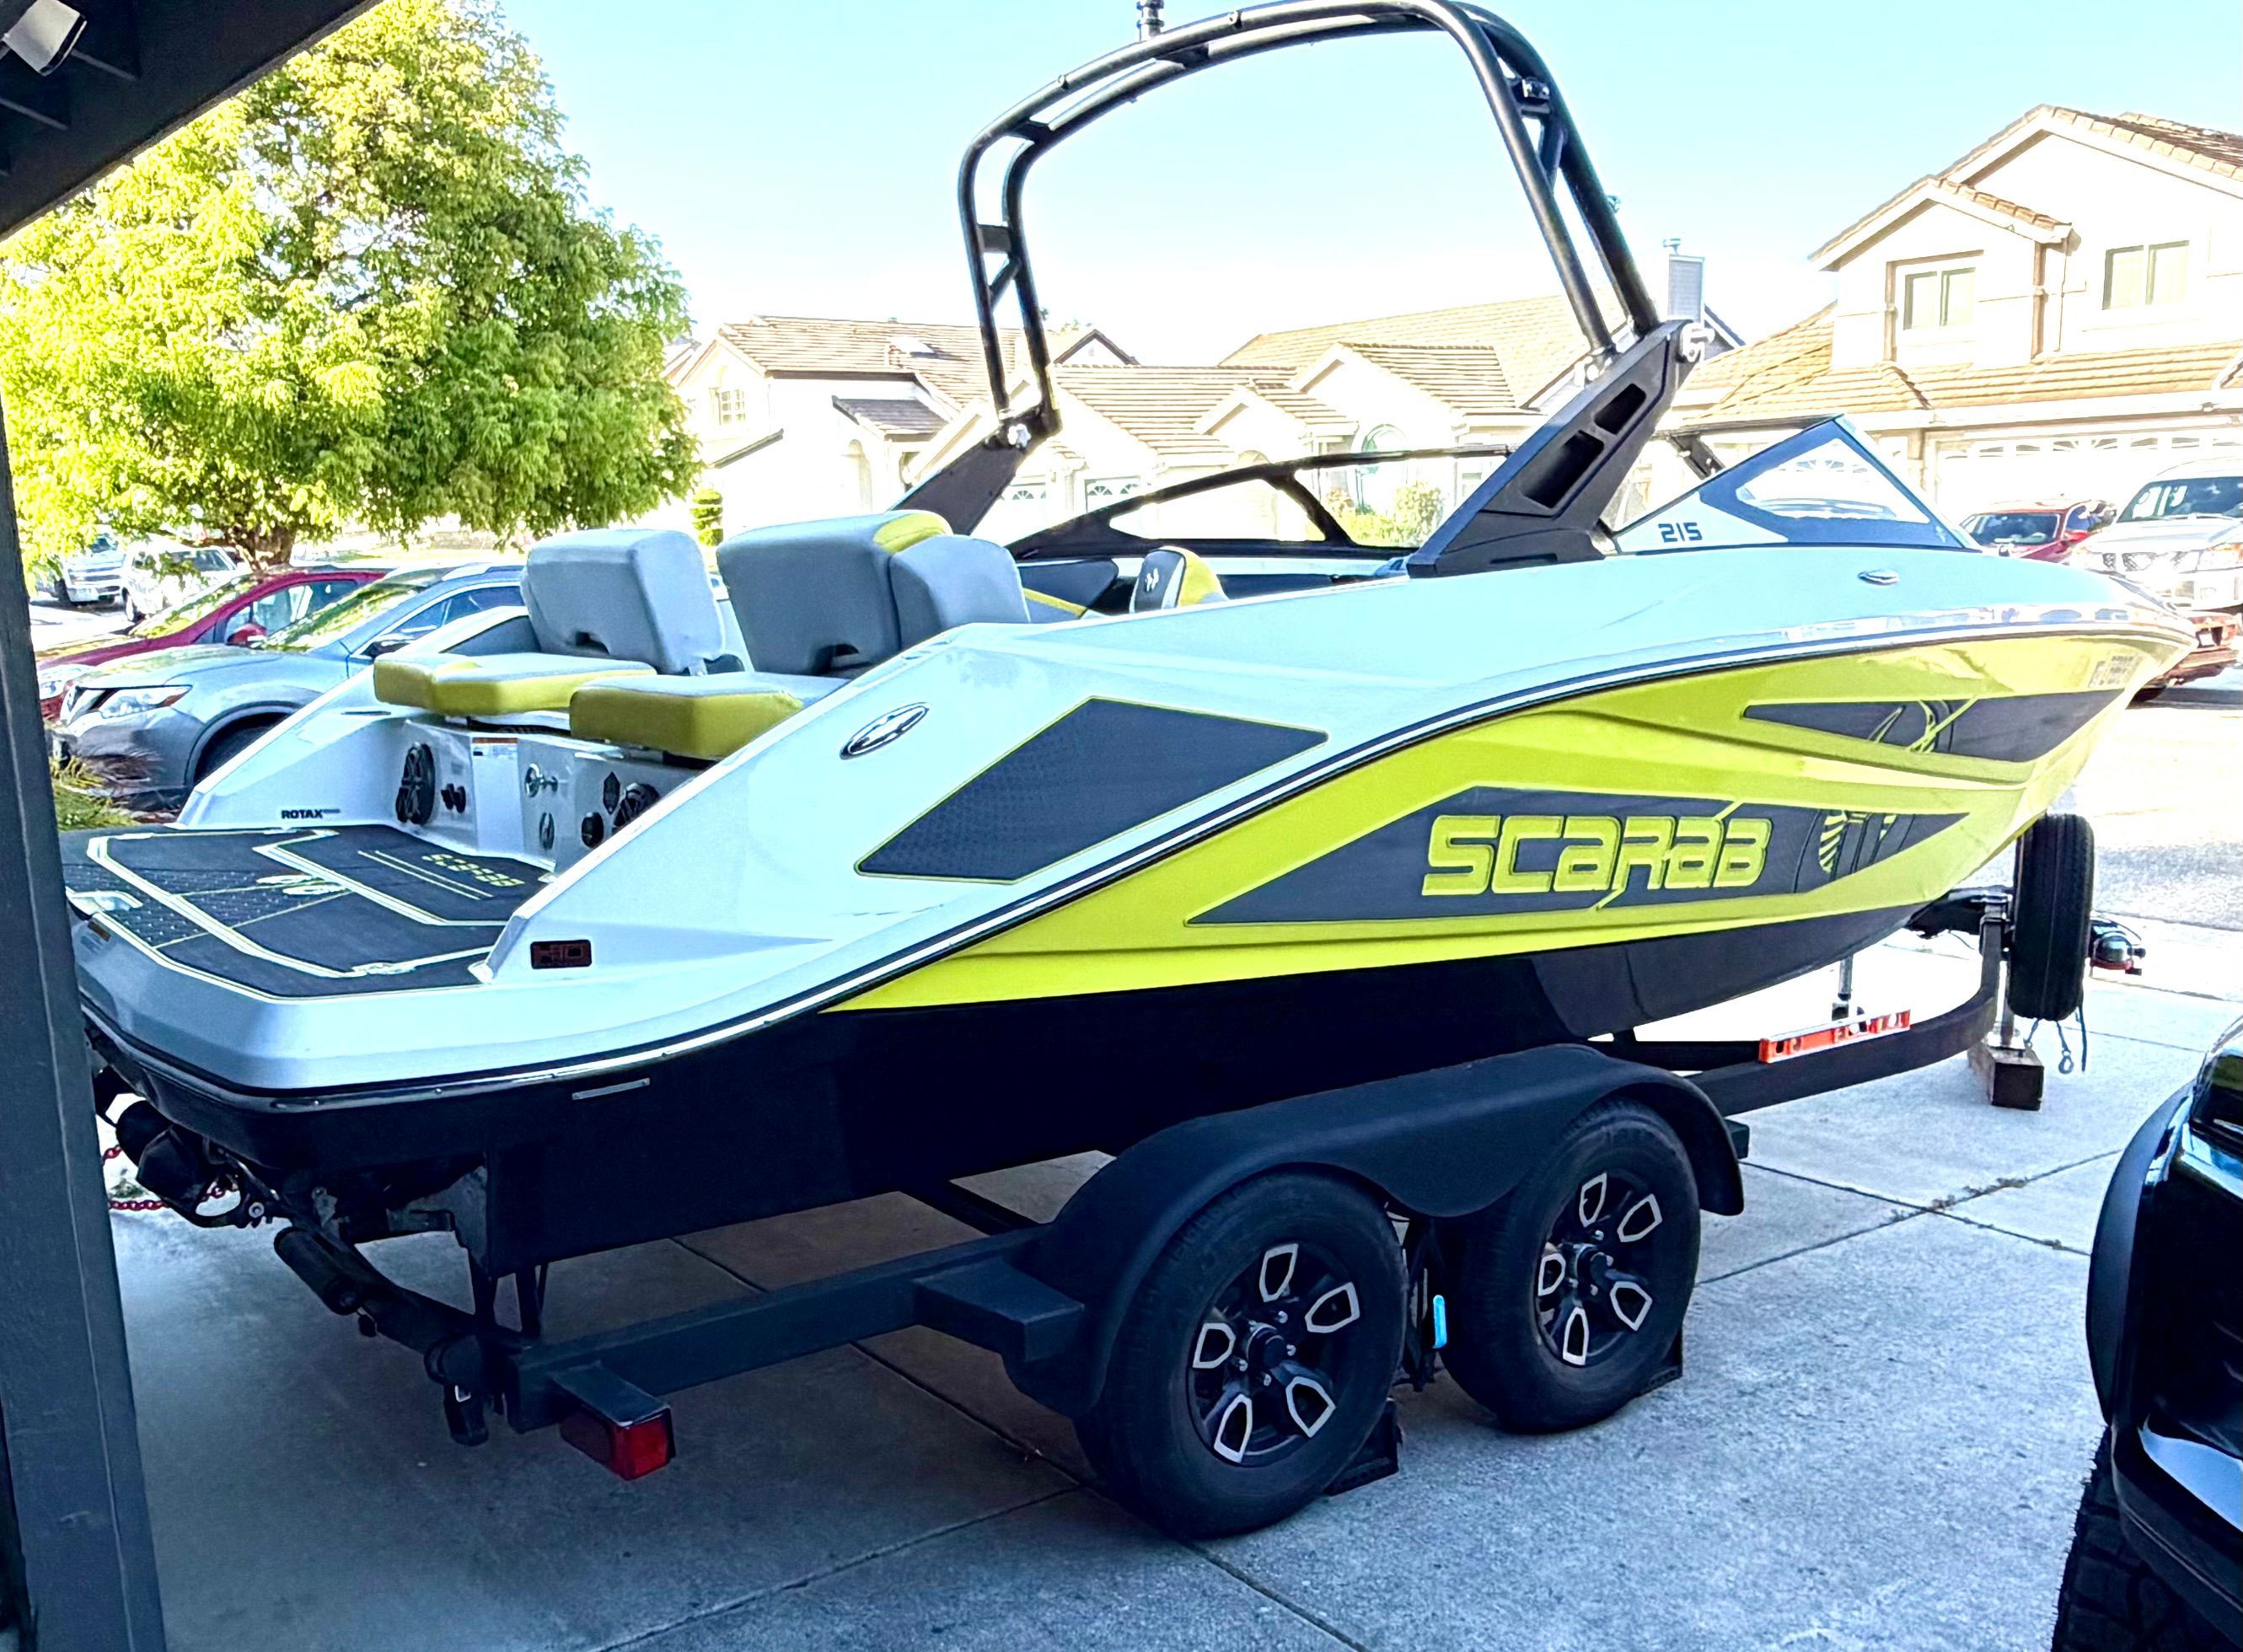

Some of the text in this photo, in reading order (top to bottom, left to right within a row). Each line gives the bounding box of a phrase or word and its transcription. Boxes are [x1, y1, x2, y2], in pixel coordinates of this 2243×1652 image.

[1658, 522, 1703, 543] 215
[281, 809, 323, 819] ROTAX
[1422, 813, 1773, 902] SCARAB
